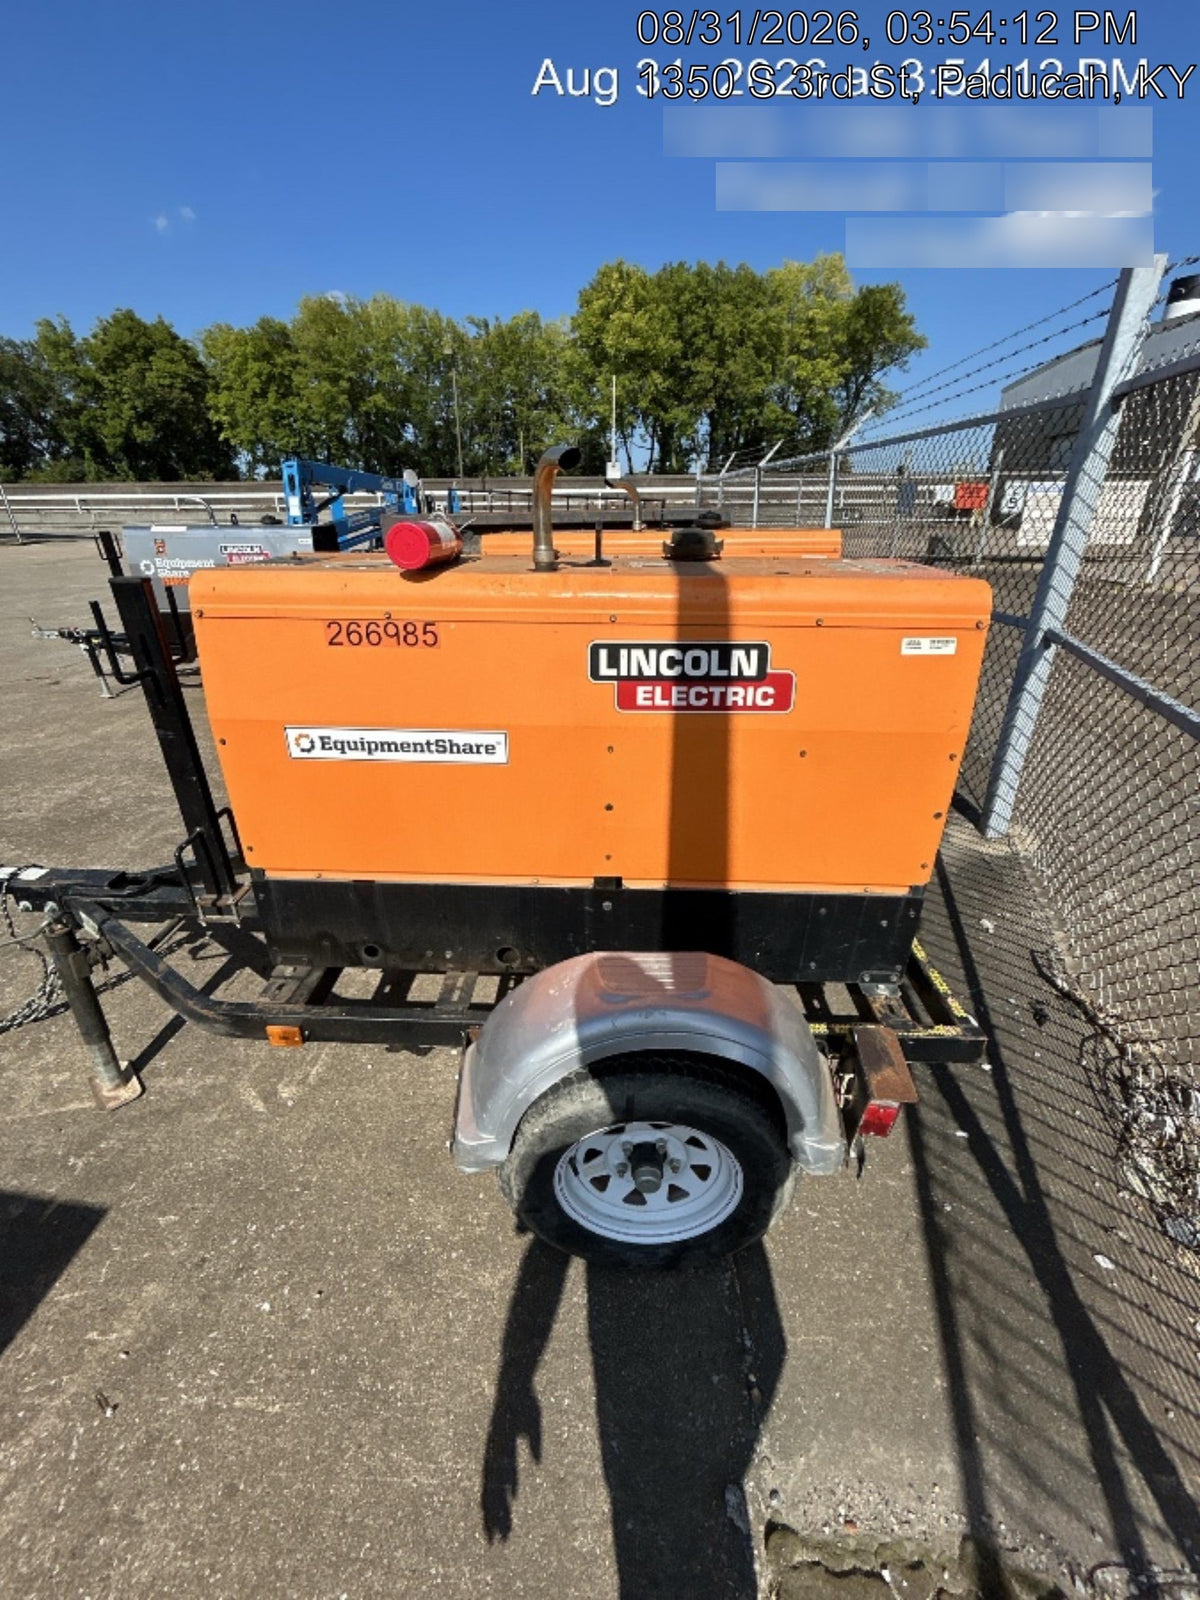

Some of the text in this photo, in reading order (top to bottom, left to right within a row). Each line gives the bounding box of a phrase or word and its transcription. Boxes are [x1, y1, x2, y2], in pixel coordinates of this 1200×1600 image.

[154, 558, 215, 569] Equipment
[157, 568, 190, 577] Share
[326, 621, 439, 647] 266985
[598, 648, 759, 677] LINCOLN
[636, 685, 776, 707] ELECTRIC
[318, 735, 497, 756] EquipmentShare
